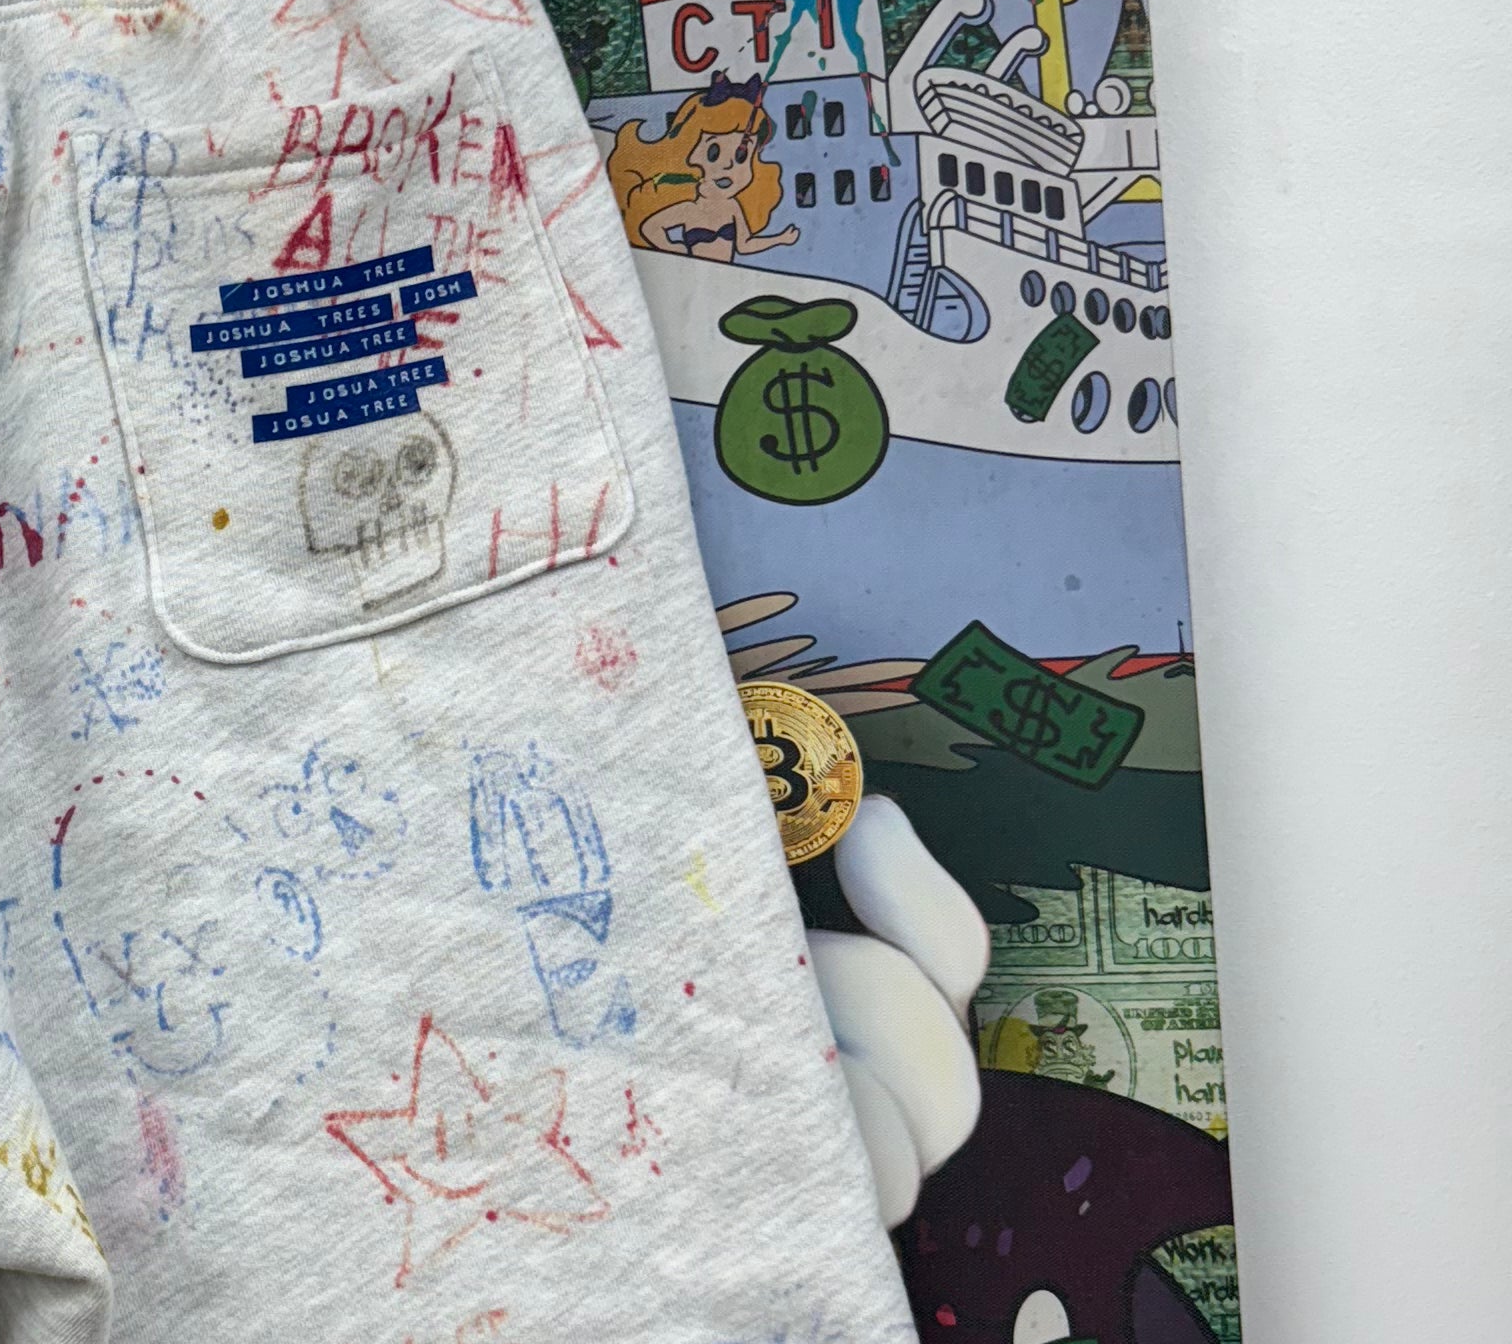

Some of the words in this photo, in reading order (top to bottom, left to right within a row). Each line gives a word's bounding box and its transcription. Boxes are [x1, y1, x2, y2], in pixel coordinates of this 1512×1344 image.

[253, 275, 343, 302] JOSHUA
[363, 258, 407, 283] TREE
[413, 280, 462, 305] JOSH
[206, 320, 291, 344] JOSHUA
[317, 303, 382, 329] TREES
[259, 341, 351, 369] JOSHUA
[360, 327, 407, 352] TREE
[307, 378, 379, 405] JOSUA
[387, 364, 435, 388] TREE
[271, 408, 349, 433] JOSUA
[360, 394, 409, 418] TREE
